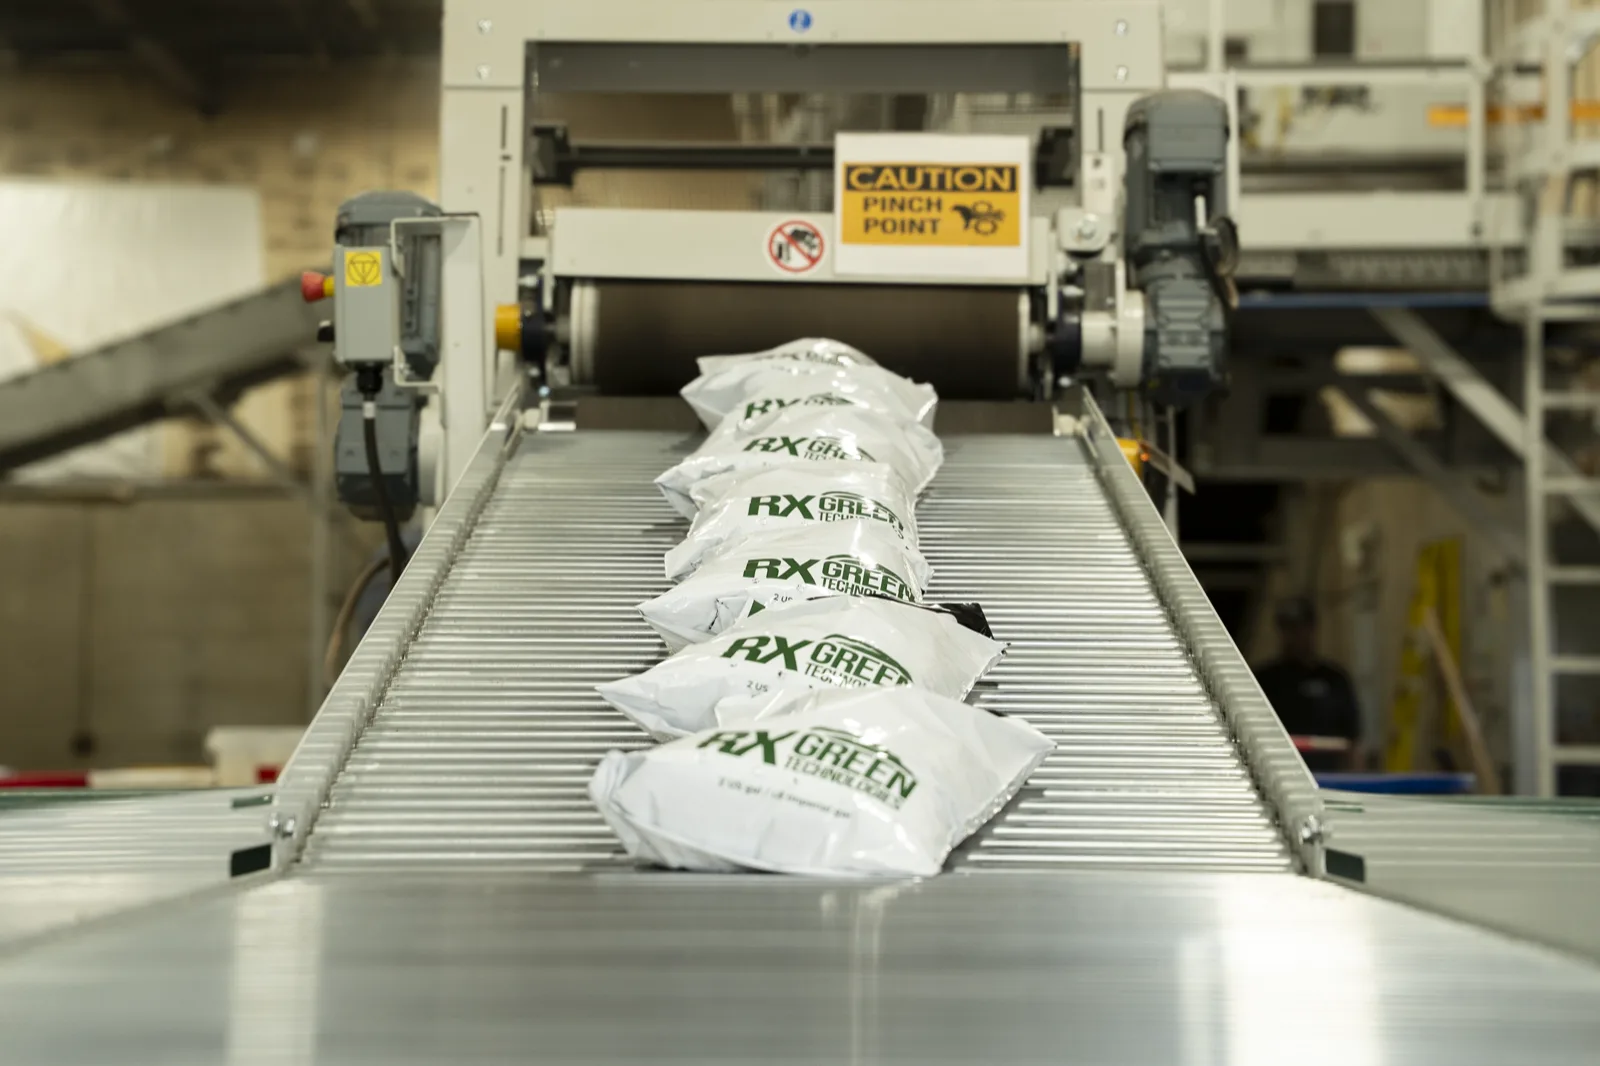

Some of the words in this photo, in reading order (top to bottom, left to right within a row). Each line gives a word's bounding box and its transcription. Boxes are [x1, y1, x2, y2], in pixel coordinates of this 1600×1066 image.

[849, 167, 1011, 190] CAUTION
[863, 196, 942, 213] PINCH
[864, 217, 941, 235] POINT
[743, 436, 809, 456] RX
[747, 495, 816, 520] RX
[743, 558, 821, 585] RX
[822, 561, 915, 603] GREEN
[720, 635, 814, 671] RX
[696, 731, 798, 765] RX
[793, 734, 917, 798] GREEN
